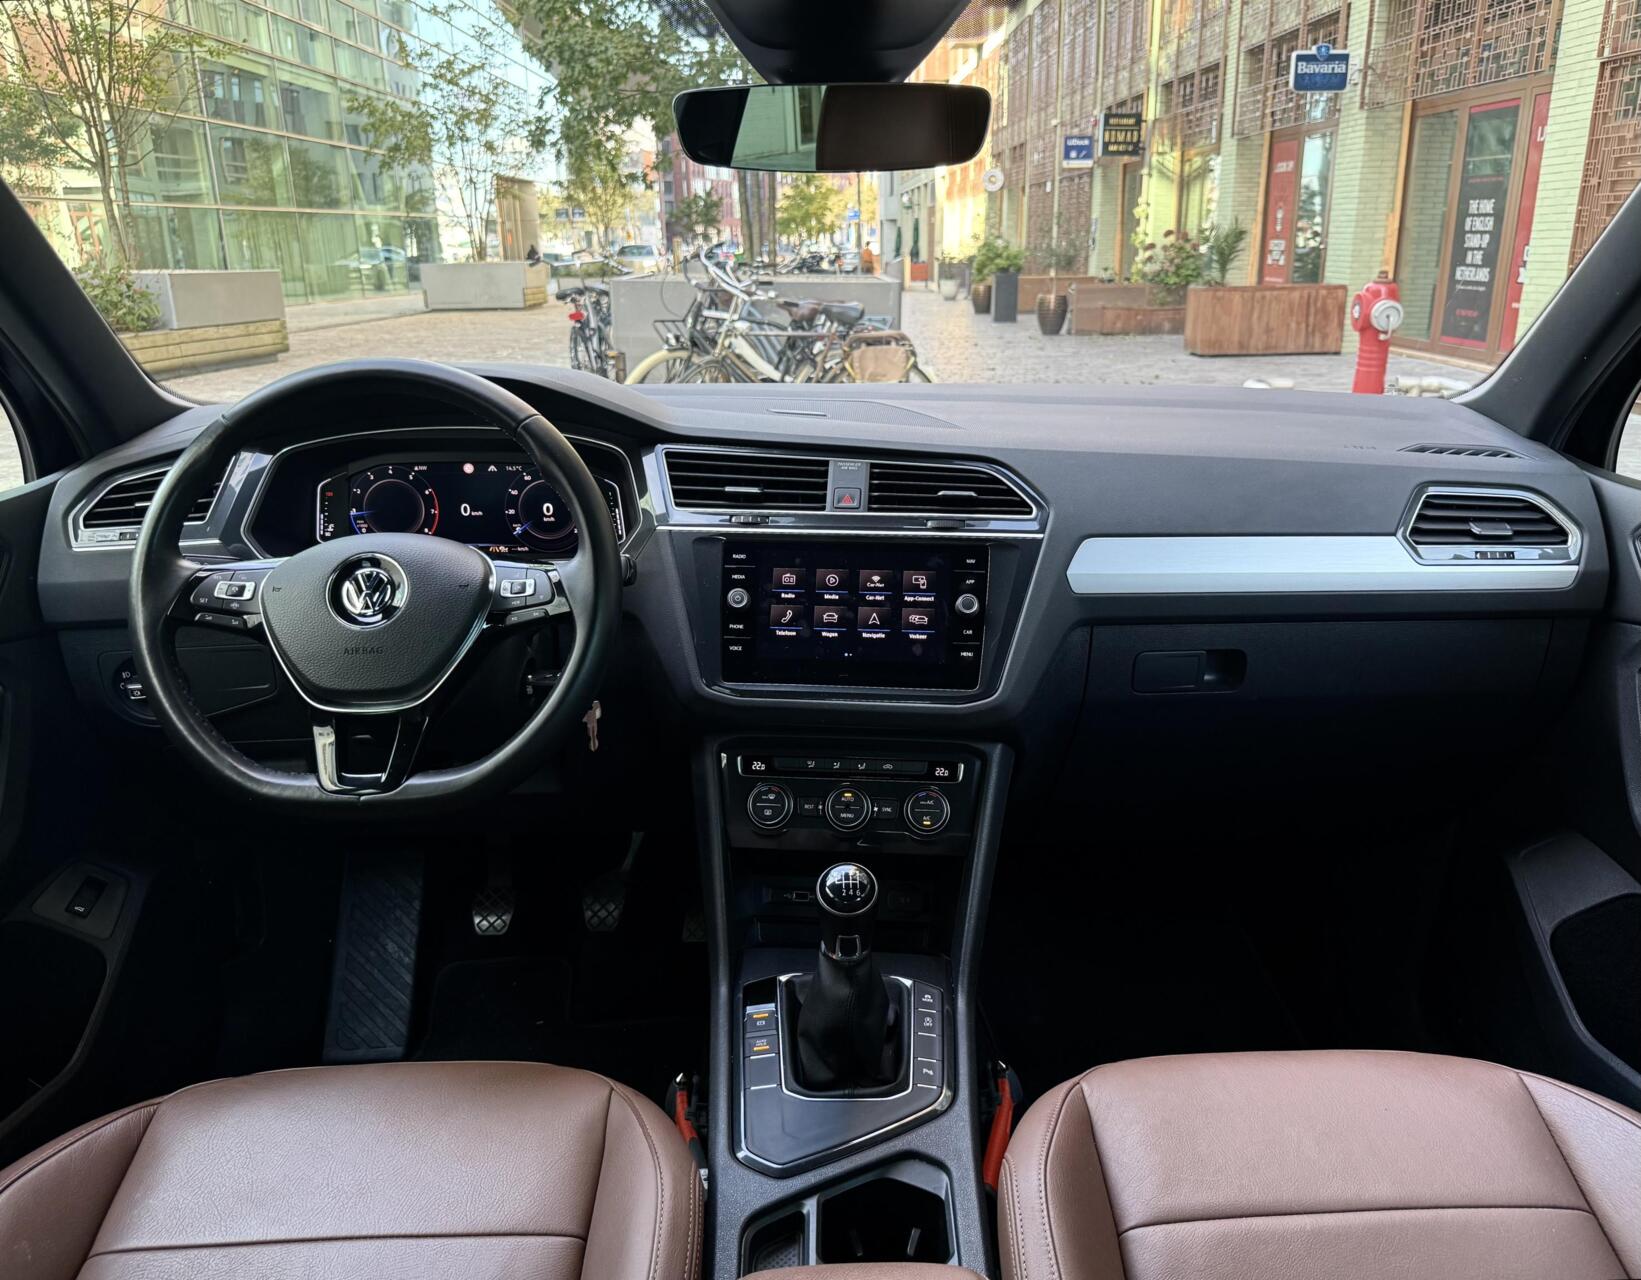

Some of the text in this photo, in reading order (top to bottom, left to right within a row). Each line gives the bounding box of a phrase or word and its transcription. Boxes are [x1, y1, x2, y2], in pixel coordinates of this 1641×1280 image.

[1297, 61, 1346, 74] Bavaria
[1469, 199, 1495, 214] THE HOME
[1465, 216, 1494, 231] OF ENGLISH
[1464, 234, 1490, 248] STAND-UP
[1465, 250, 1484, 265] IN THE
[1455, 266, 1490, 282] NETHERLANDS
[461, 503, 471, 517] 0
[542, 502, 554, 516] 0
[343, 646, 384, 656] AIRBAG
